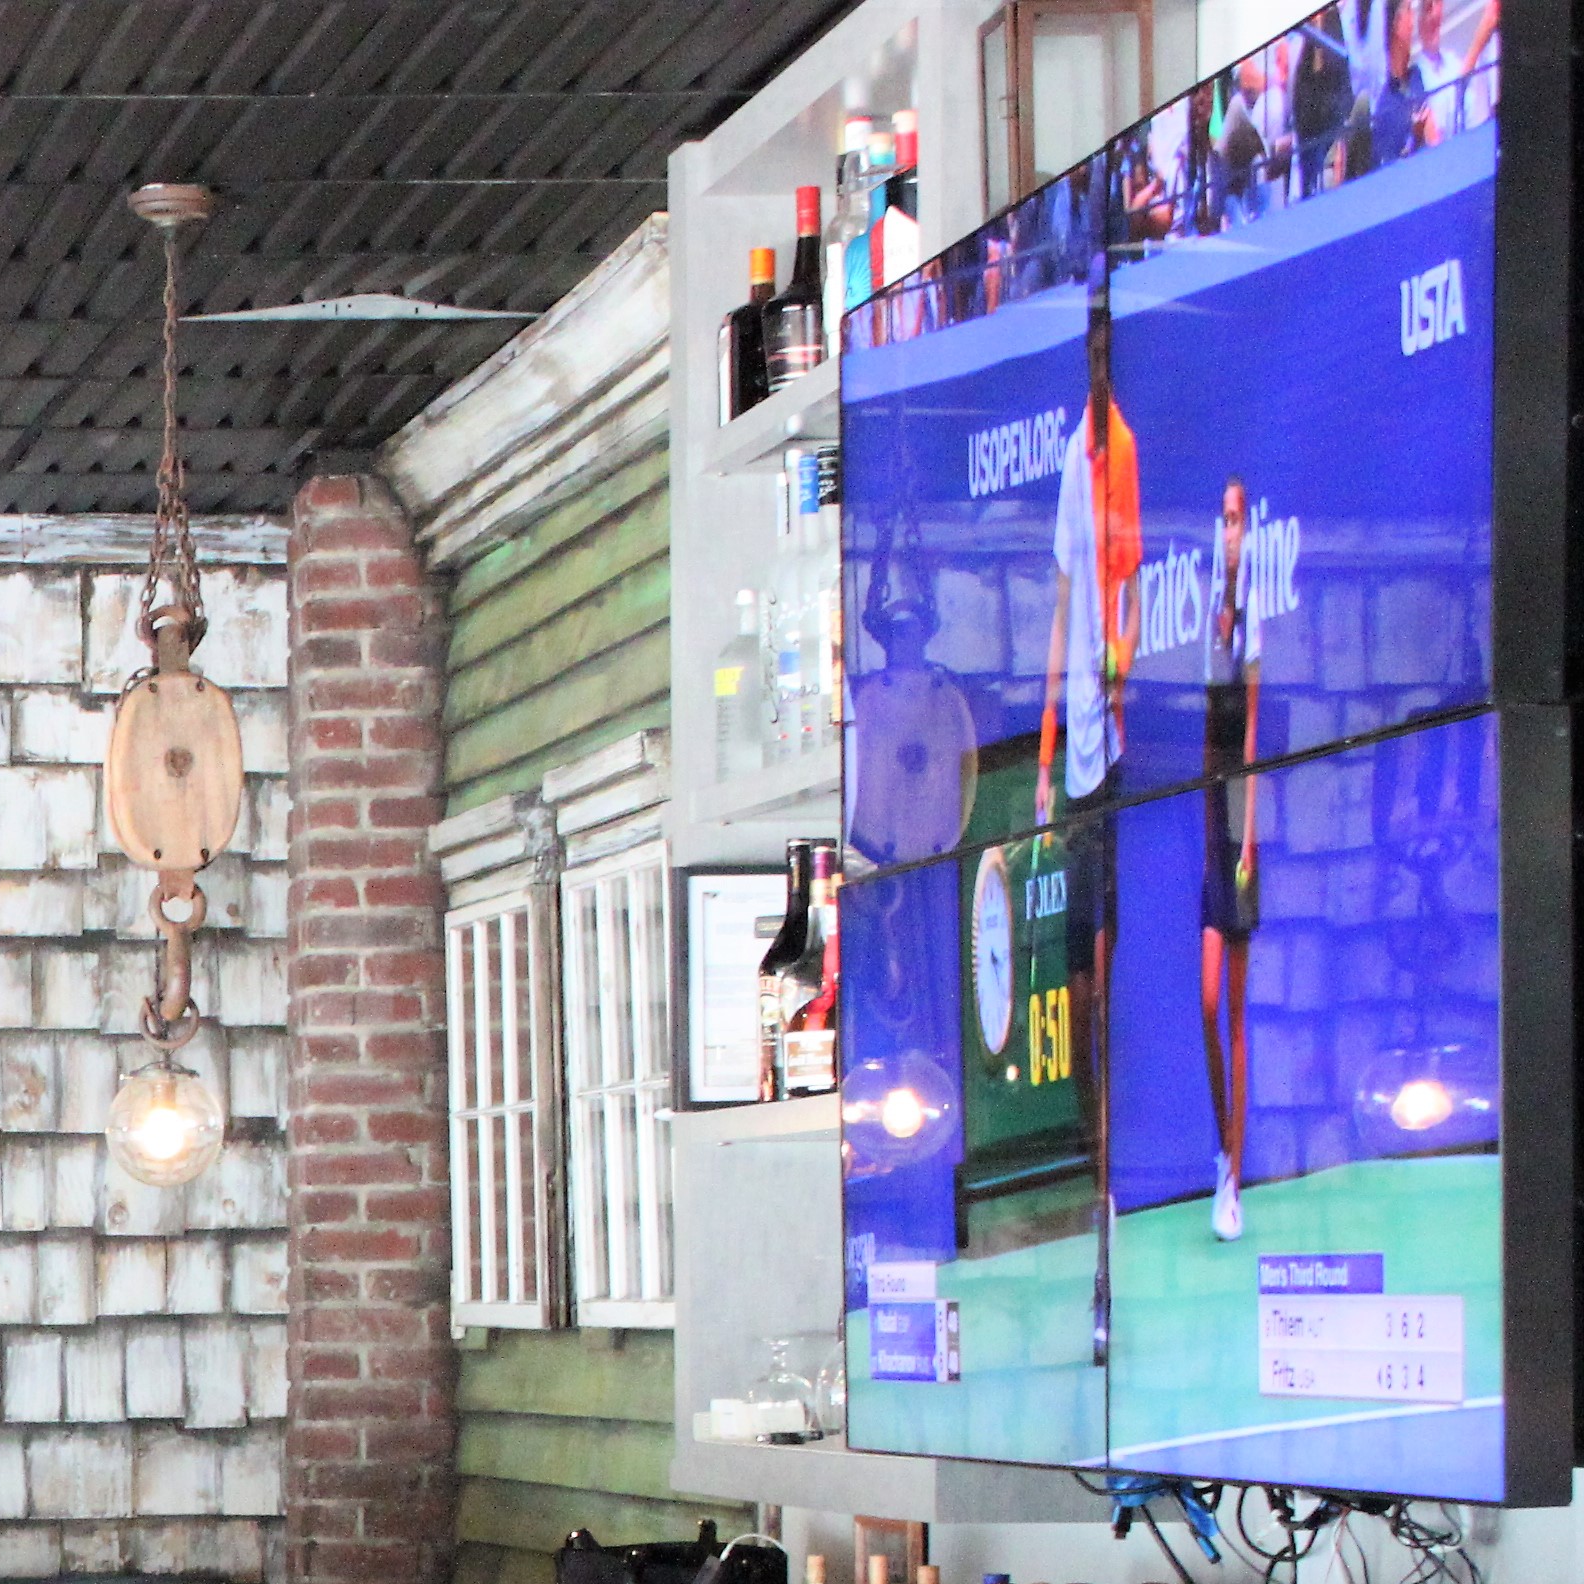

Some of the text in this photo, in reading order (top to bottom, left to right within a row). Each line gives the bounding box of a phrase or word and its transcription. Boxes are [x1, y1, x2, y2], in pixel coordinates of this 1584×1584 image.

[1399, 258, 1466, 357] USTA
[967, 405, 1067, 499] USOPEN.ORG
[1028, 985, 1073, 1087] 0:50
